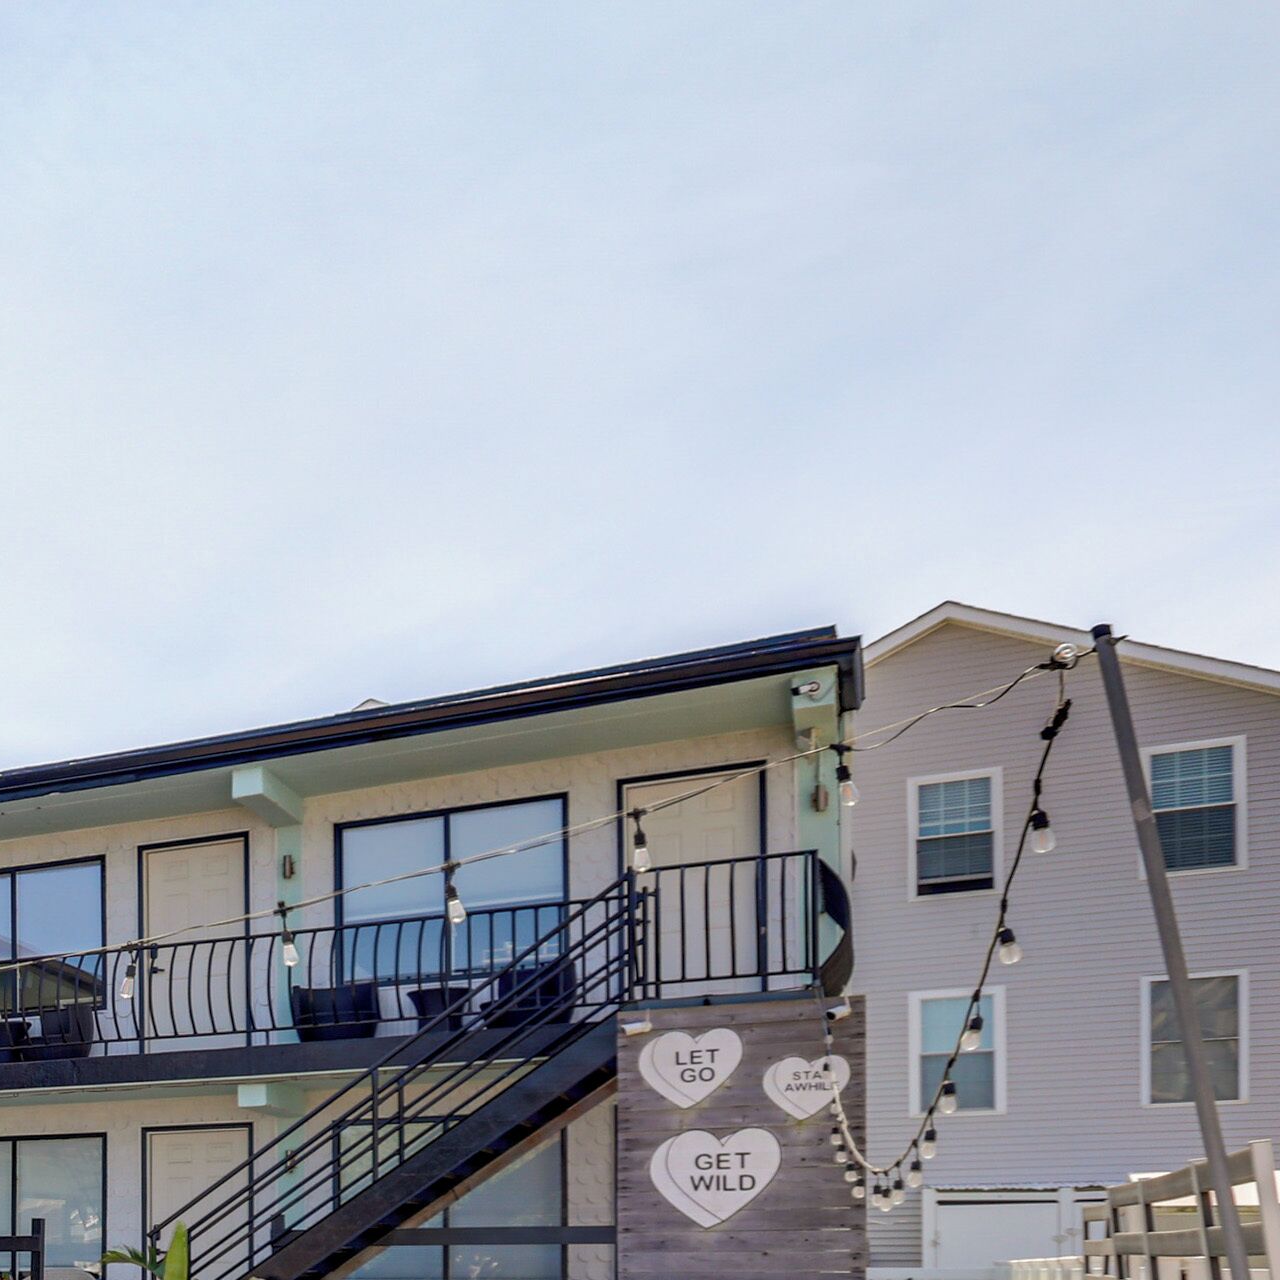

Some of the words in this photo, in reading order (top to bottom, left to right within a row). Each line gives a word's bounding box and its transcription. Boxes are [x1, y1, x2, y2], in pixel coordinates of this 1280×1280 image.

[675, 1049, 720, 1065] LET
[680, 1067, 715, 1082] GO
[793, 1071, 833, 1080] STA
[694, 1152, 751, 1170] GET
[690, 1174, 756, 1191] WILD
